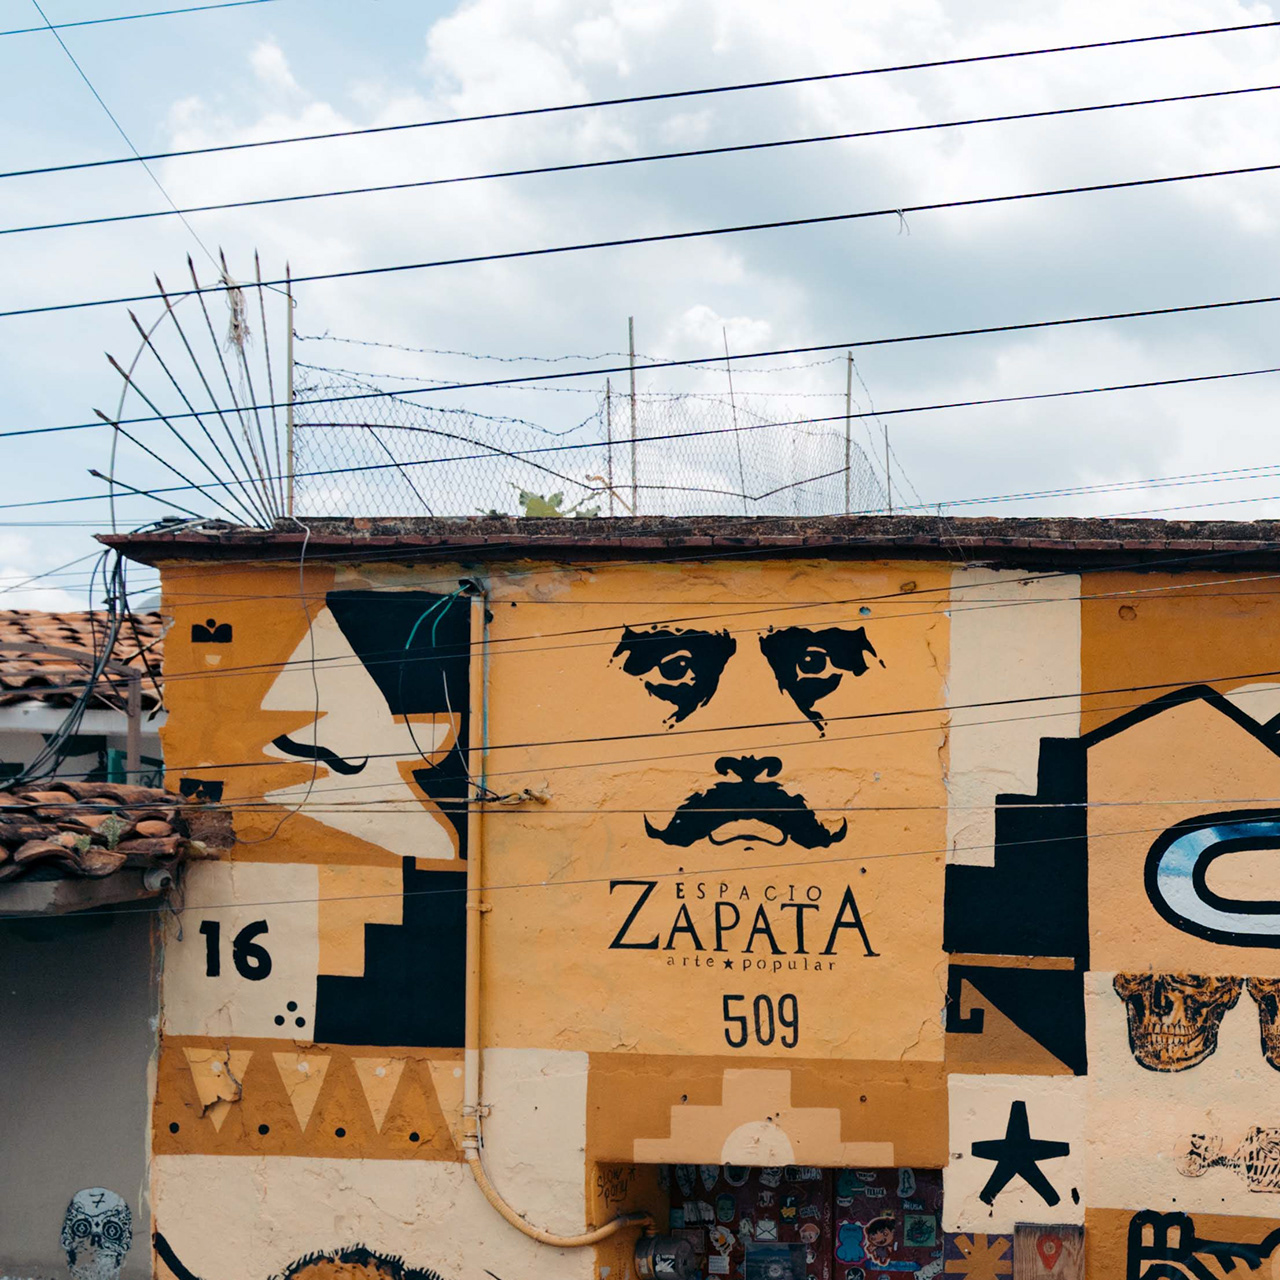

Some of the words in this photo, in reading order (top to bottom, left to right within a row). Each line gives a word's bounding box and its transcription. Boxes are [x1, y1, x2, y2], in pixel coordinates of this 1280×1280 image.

[608, 879, 881, 958] ZAPATA
[675, 882, 822, 902] ESPACIO
[198, 919, 273, 982] 16
[666, 954, 715, 968] arte
[742, 957, 837, 974] popular
[722, 993, 799, 1049] 509
